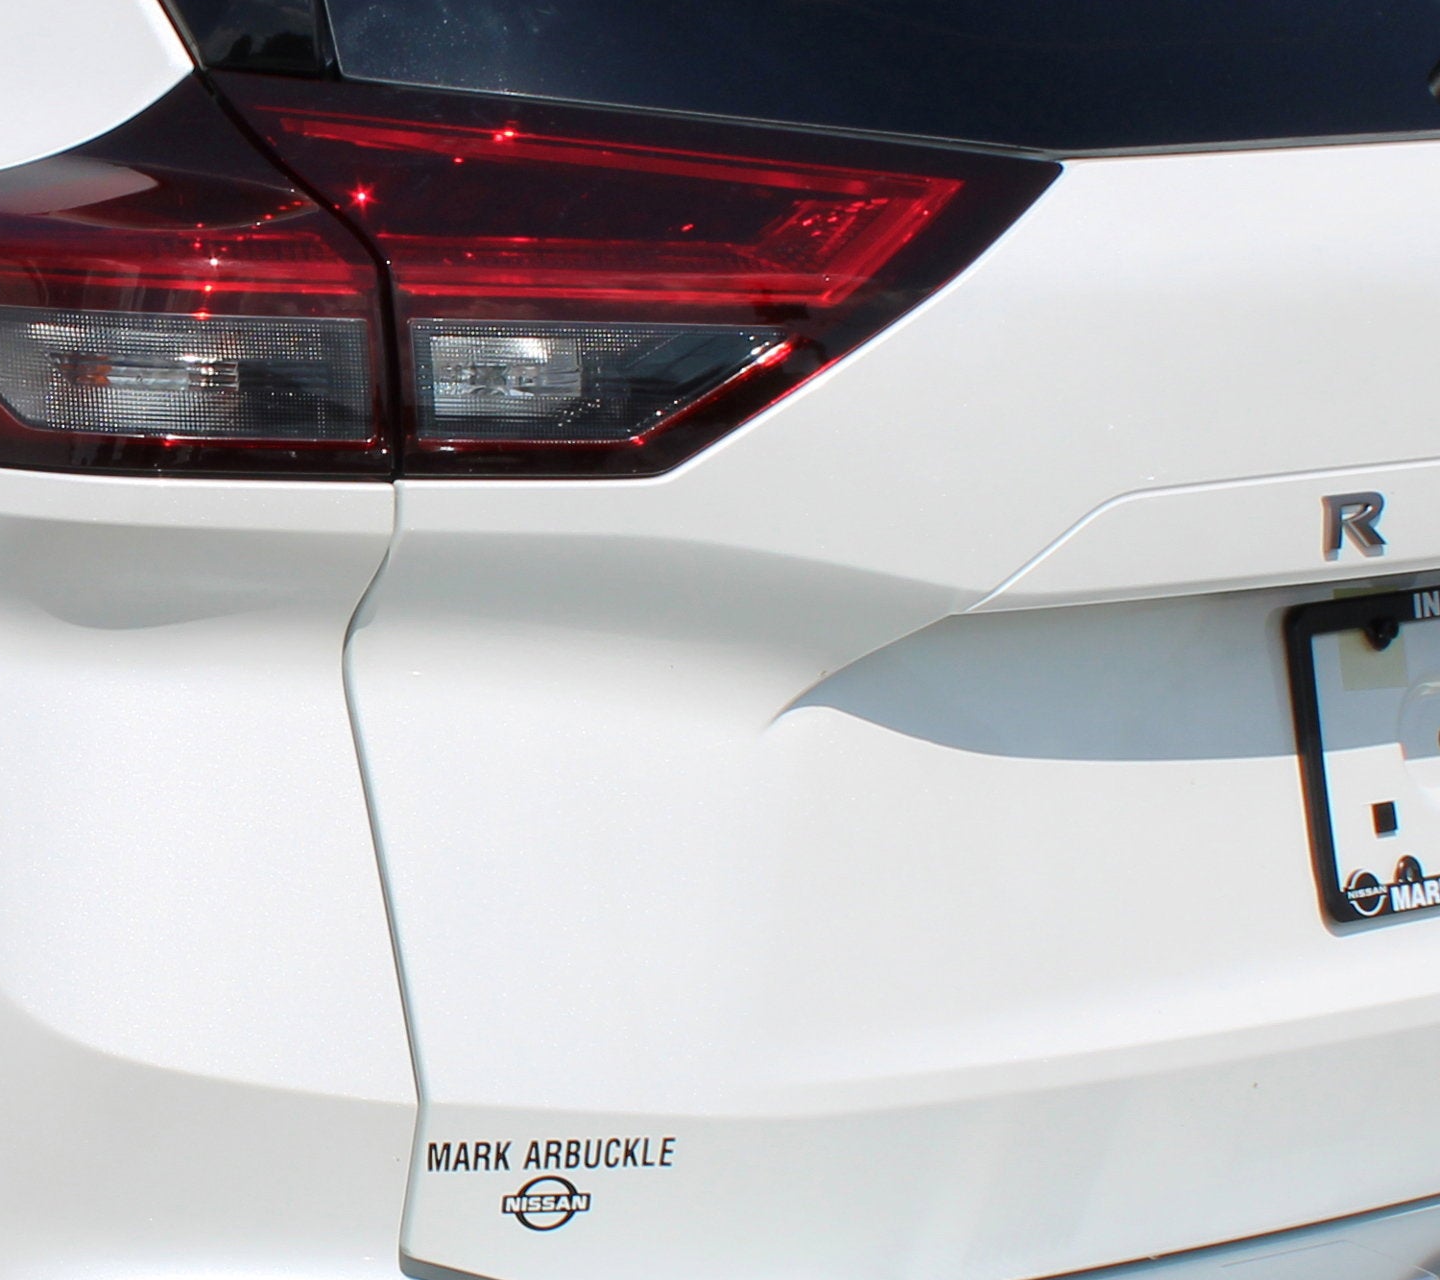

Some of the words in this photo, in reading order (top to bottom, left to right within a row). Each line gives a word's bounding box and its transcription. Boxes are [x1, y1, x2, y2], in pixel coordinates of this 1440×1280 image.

[1346, 884, 1388, 901] NISSAN
[426, 1141, 513, 1172] MARK
[523, 1136, 677, 1170] ARBUCKLE
[504, 1194, 589, 1213] NISSAN
